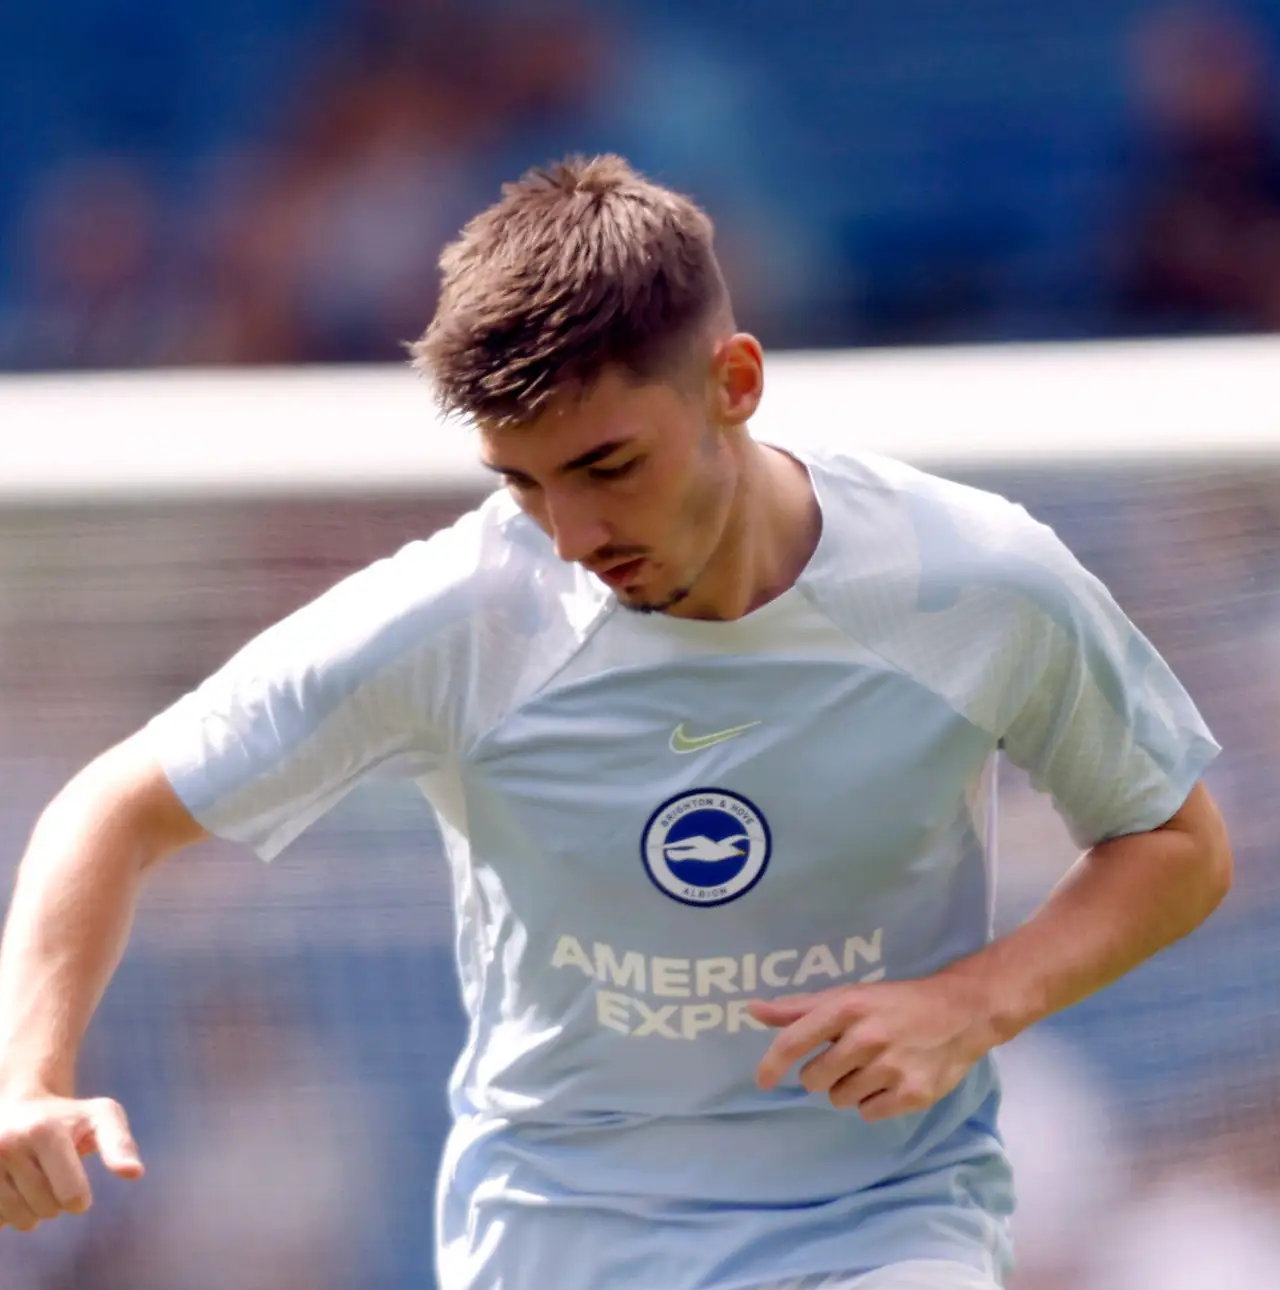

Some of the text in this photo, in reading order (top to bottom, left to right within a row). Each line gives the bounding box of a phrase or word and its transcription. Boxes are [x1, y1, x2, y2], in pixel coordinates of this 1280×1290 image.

[660, 797, 715, 828] BRIGHTON
[730, 803, 755, 826] HOVE
[682, 886, 728, 898] ALBION
[551, 927, 885, 997] AMERICAN
